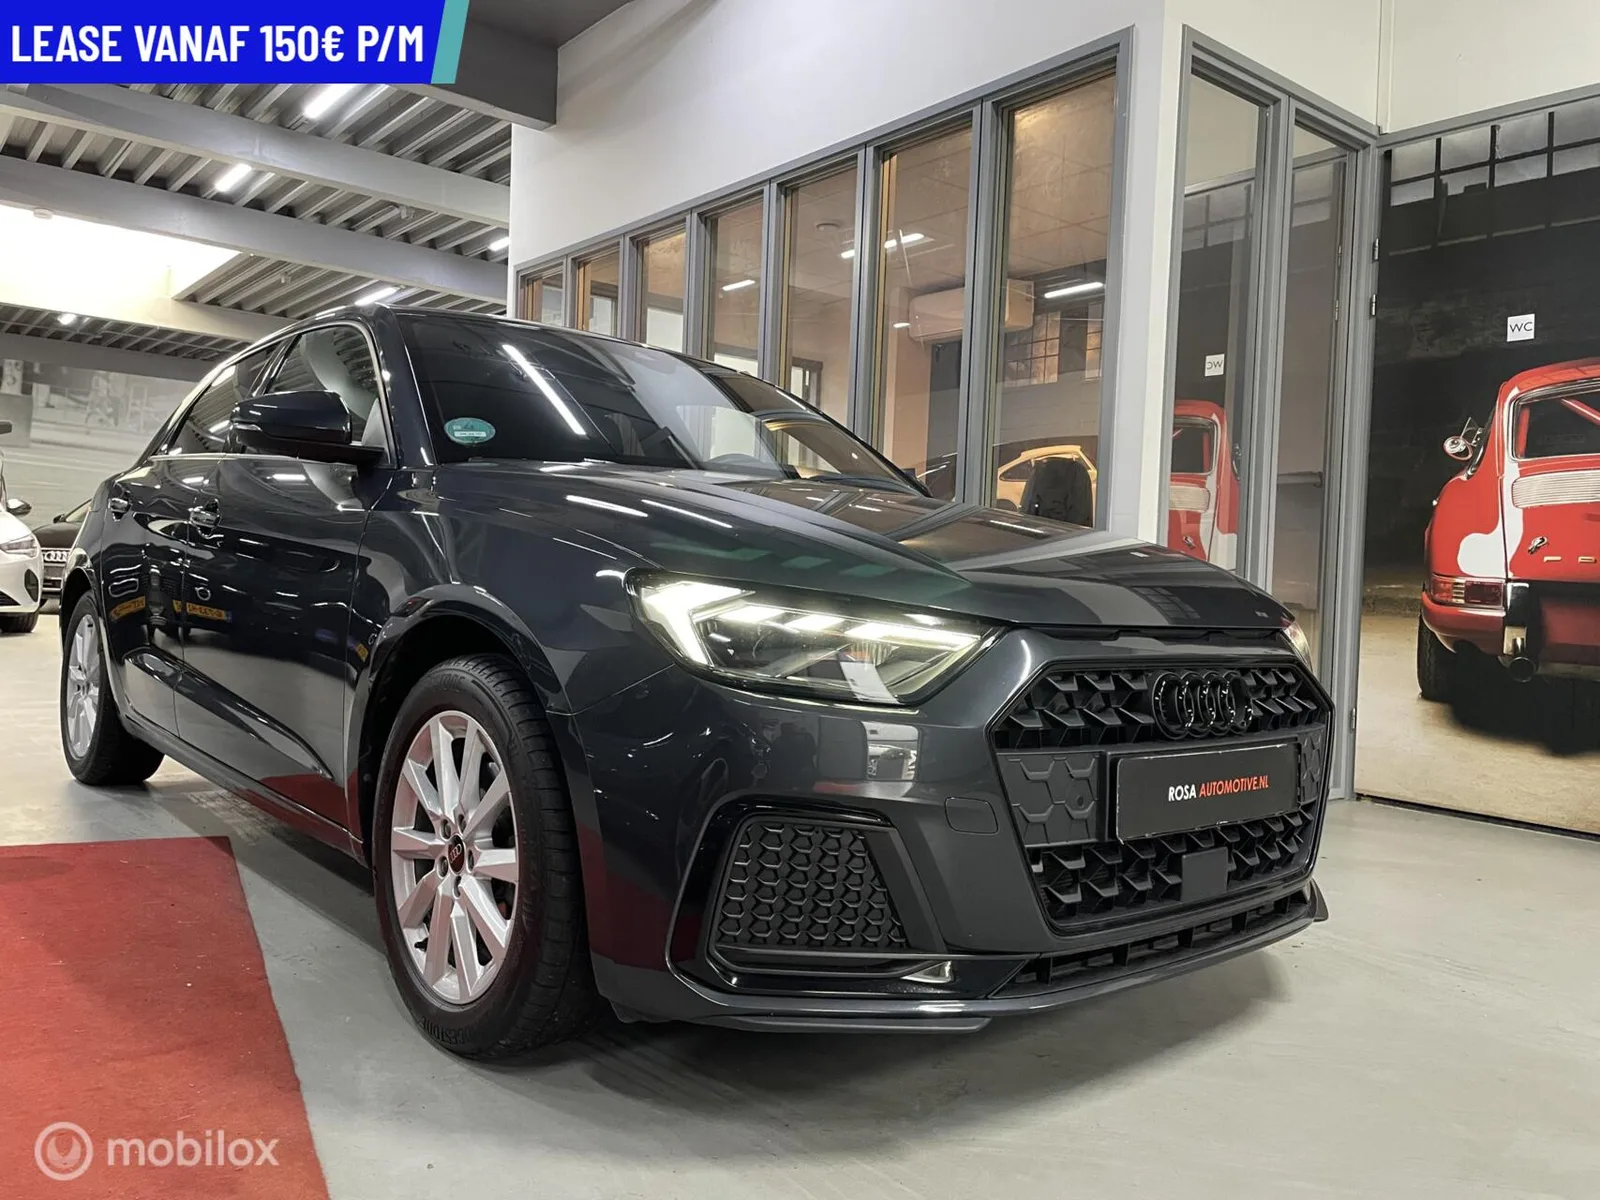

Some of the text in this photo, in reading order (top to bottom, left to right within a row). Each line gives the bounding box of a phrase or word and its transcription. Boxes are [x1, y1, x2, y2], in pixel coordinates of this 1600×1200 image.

[1509, 321, 1533, 333] WC
[1168, 775, 1269, 802] ROSA AUTOMOTIVE.NL
